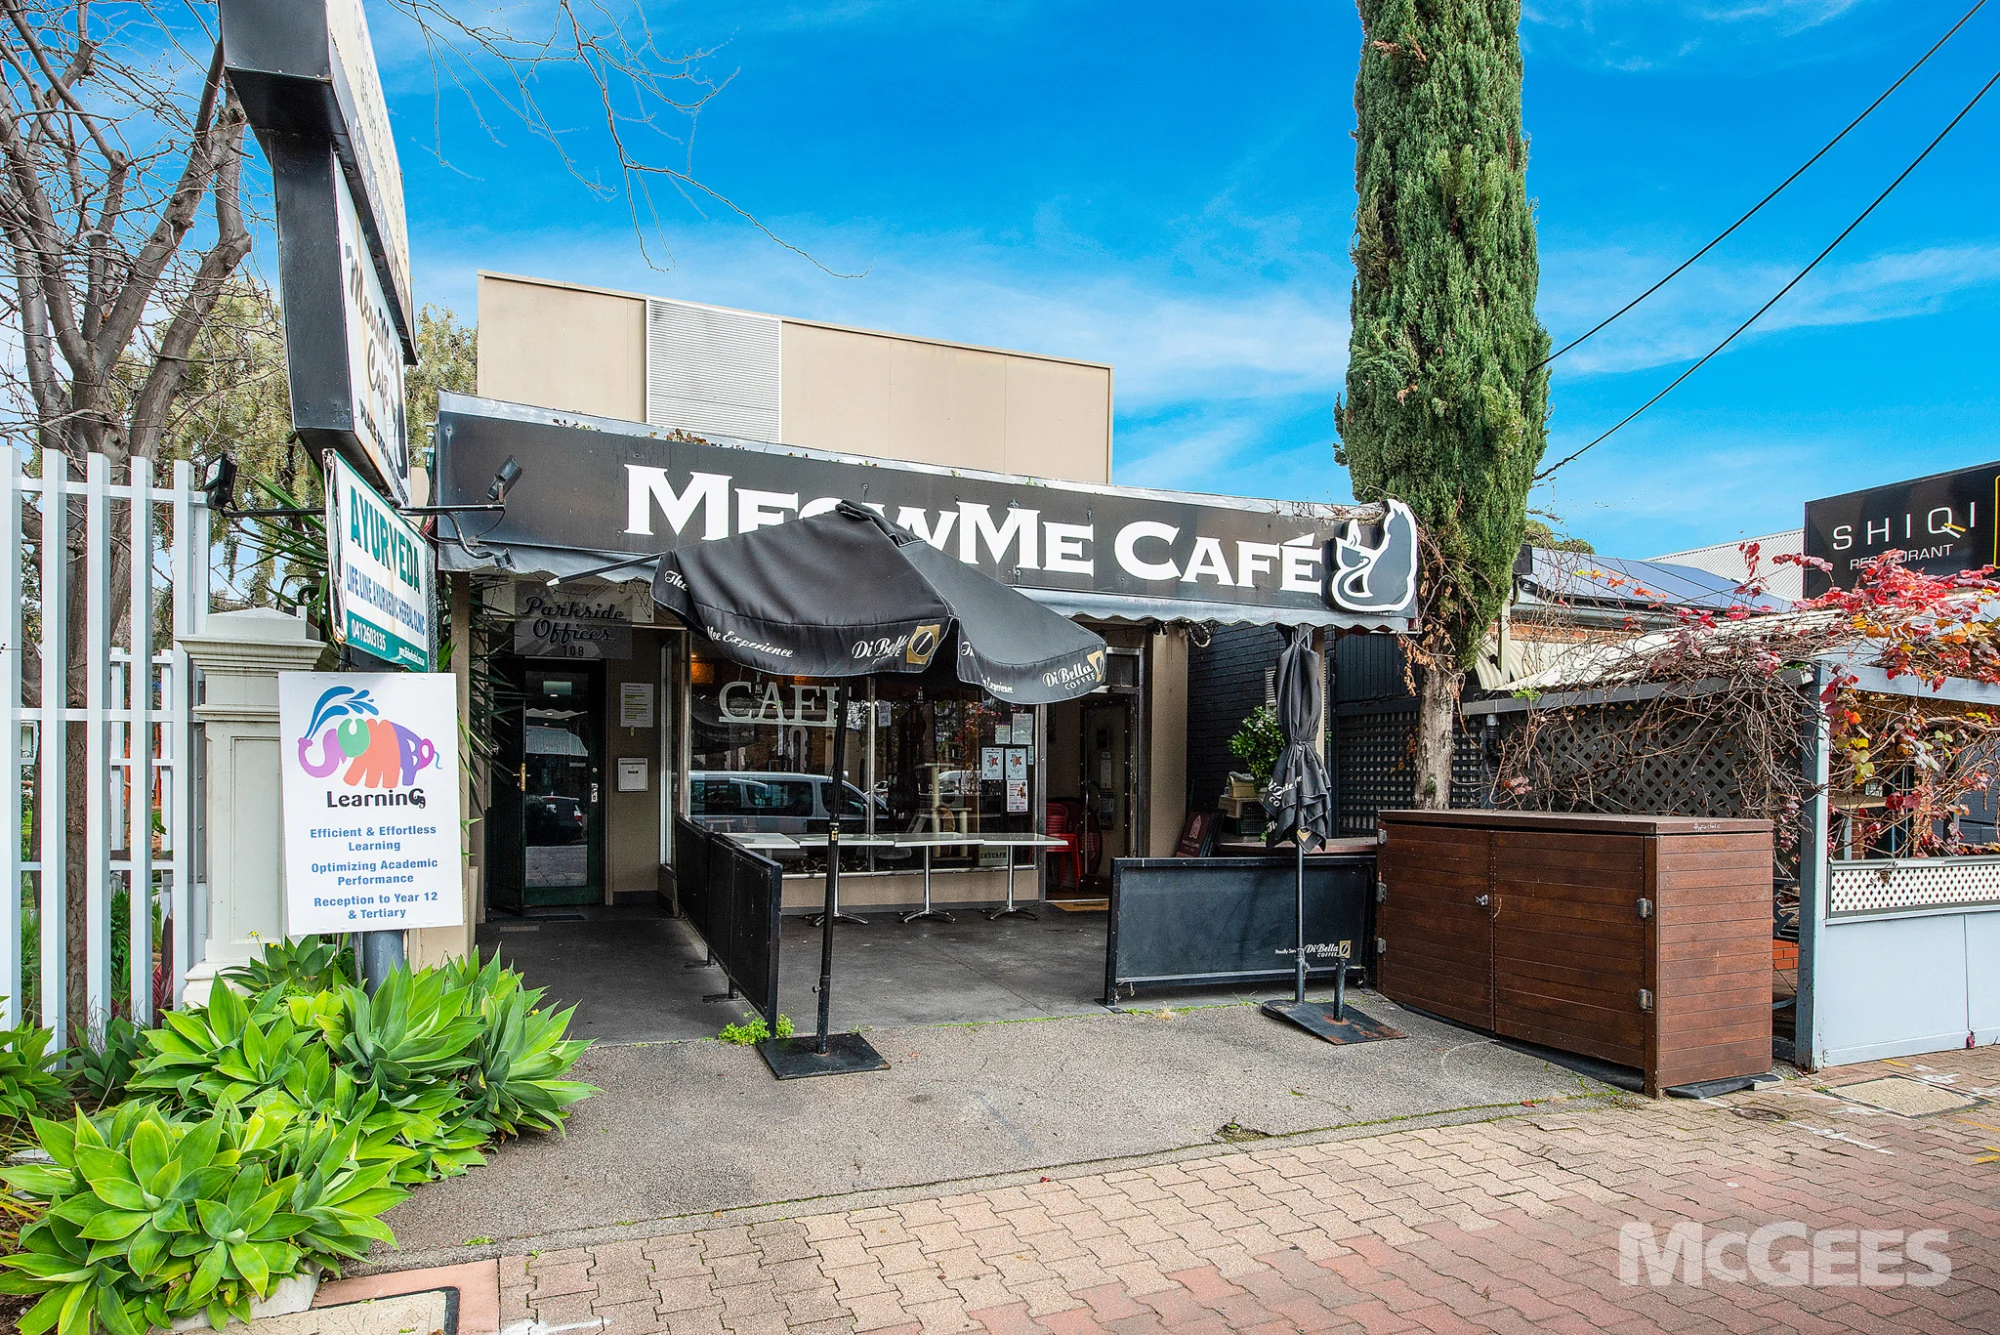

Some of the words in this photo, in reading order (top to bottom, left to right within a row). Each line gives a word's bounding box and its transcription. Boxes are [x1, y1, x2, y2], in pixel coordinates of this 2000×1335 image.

[1832, 501, 1976, 551] SHIQI
[350, 484, 421, 595] AYURVEDA
[1113, 520, 1324, 597] CAFÉ
[346, 561, 359, 596] LIFE
[359, 570, 372, 605] LINE
[520, 596, 628, 621] Parkside
[533, 618, 614, 644] Offices
[562, 645, 584, 657] 108
[722, 630, 794, 658] Experience
[1064, 672, 1096, 690] COFFEE
[310, 826, 362, 839] Efficient
[366, 826, 375, 837] &
[379, 824, 437, 836] Effortless
[348, 841, 401, 853] Learning
[311, 861, 377, 874] Optimizing
[380, 858, 438, 870] Academic
[337, 873, 414, 886] Performance
[314, 895, 374, 909] Reception
[379, 895, 390, 905] to
[394, 892, 419, 904] Year
[424, 891, 438, 902] 12
[348, 911, 357, 920] &
[361, 908, 406, 920] Tertiary
